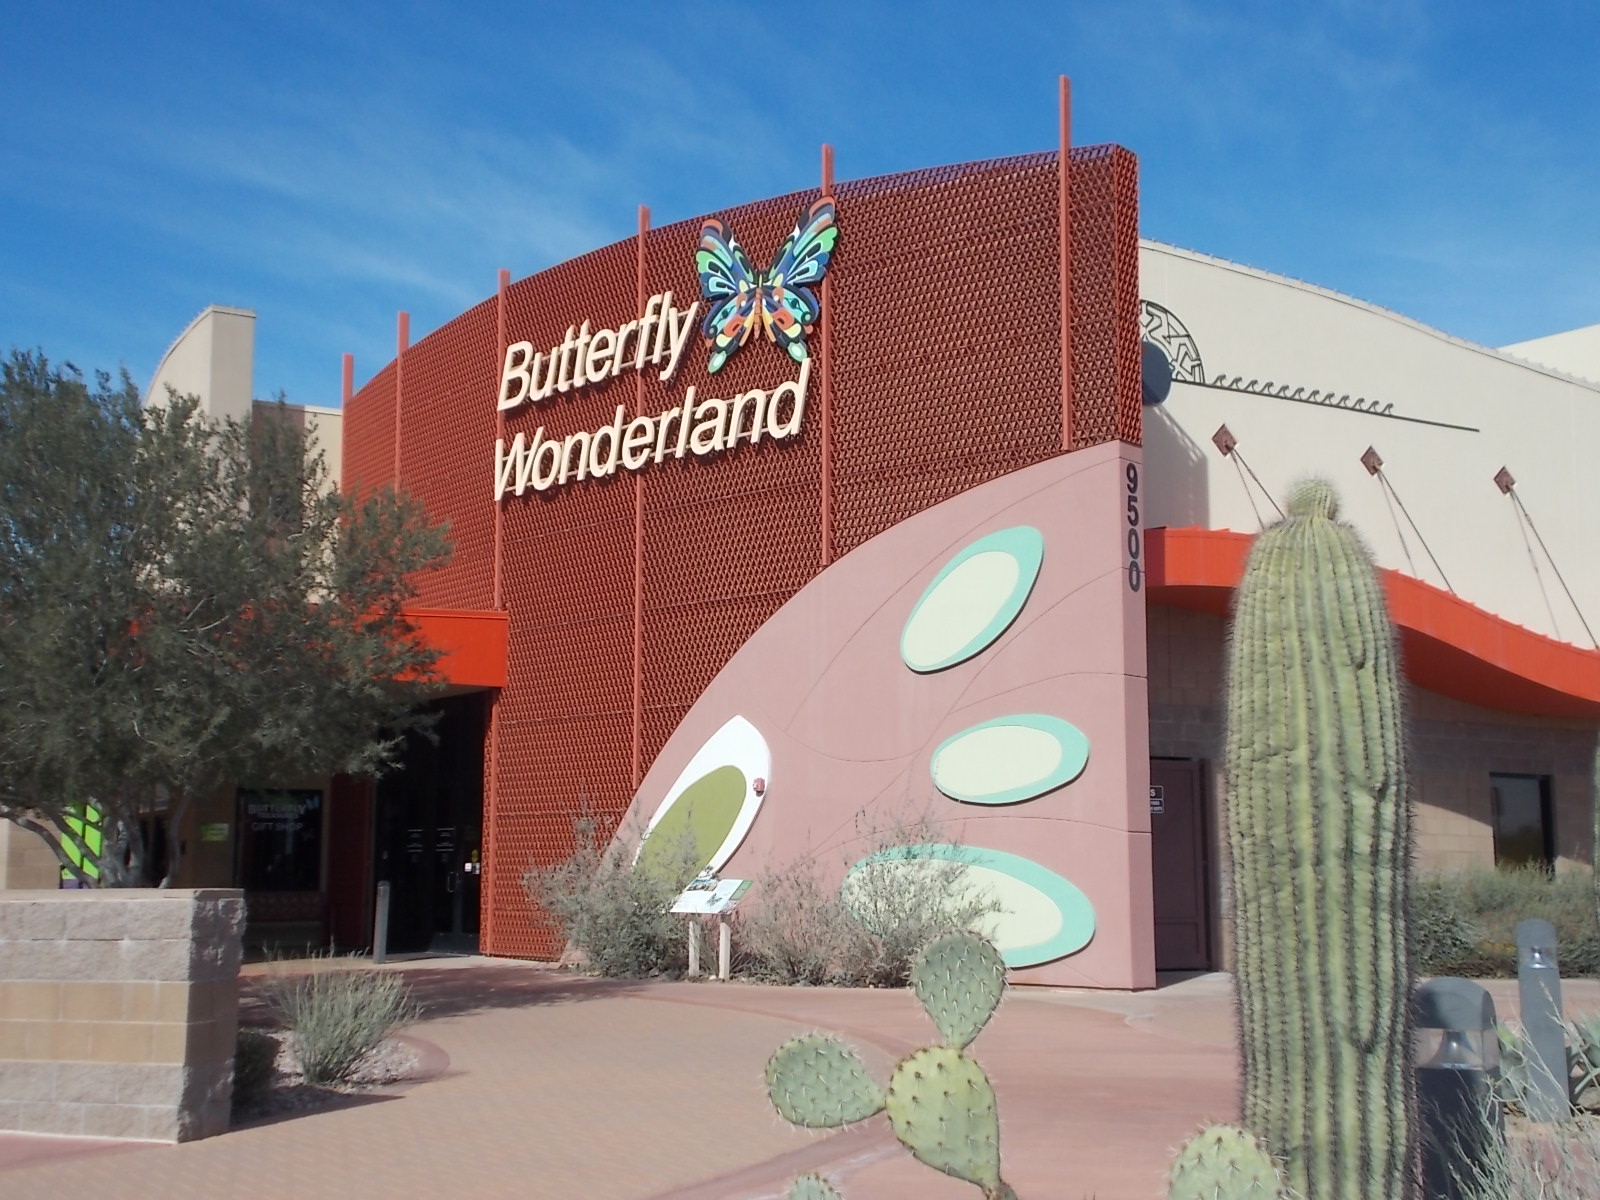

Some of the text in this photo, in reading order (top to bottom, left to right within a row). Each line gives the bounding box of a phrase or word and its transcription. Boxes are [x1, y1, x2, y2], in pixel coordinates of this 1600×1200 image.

[497, 291, 699, 411] Butterfly
[494, 358, 811, 501] Wonderland
[1126, 463, 1140, 592] 9500
